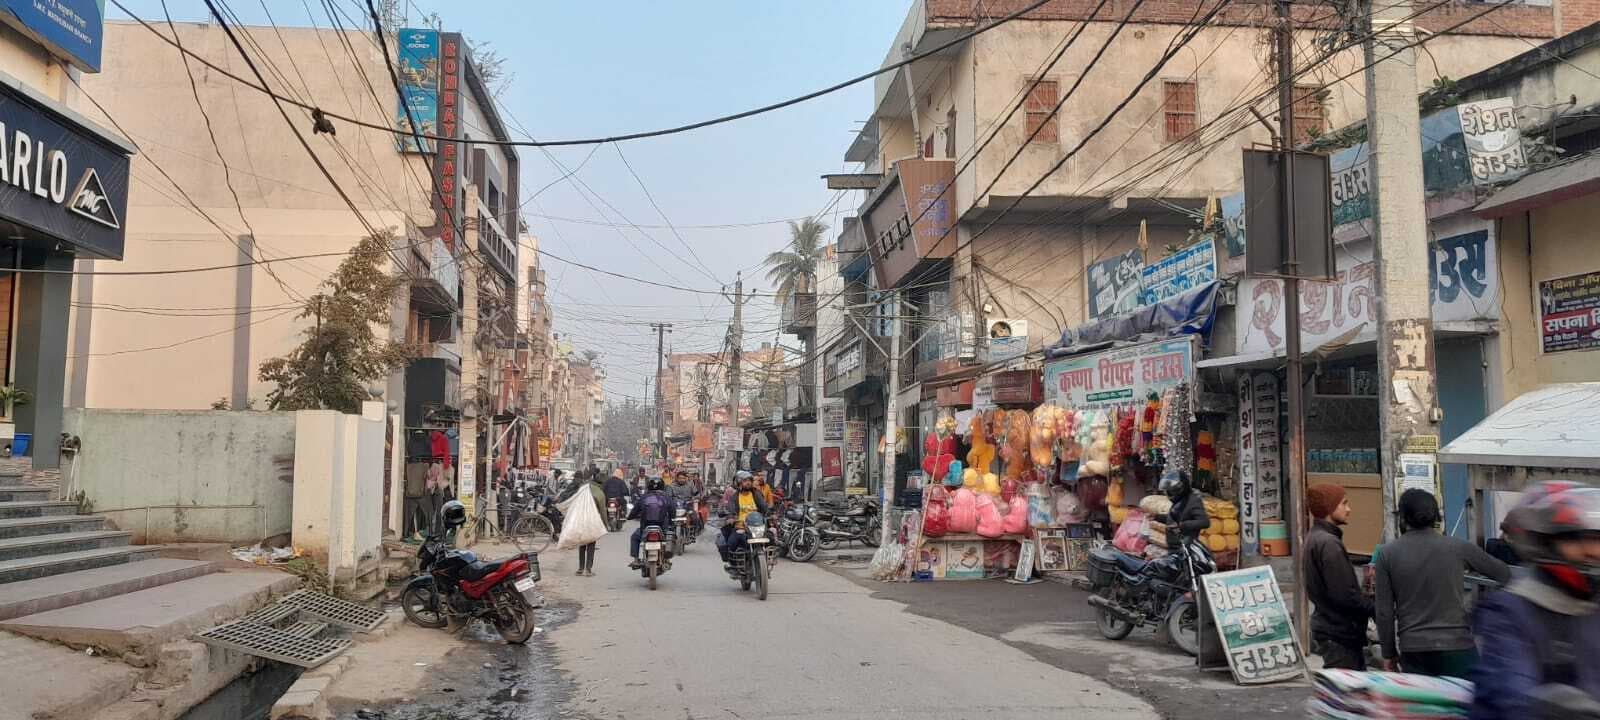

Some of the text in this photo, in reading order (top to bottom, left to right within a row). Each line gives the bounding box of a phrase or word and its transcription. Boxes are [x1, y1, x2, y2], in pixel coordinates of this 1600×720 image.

[443, 41, 457, 138] BOMBAY
[1471, 145, 1527, 180] हाउस
[1427, 229, 1489, 303] ाउस
[1544, 314, 1589, 333] सपना
[1140, 351, 1185, 384] हाउस
[1231, 642, 1299, 679] हाउस
